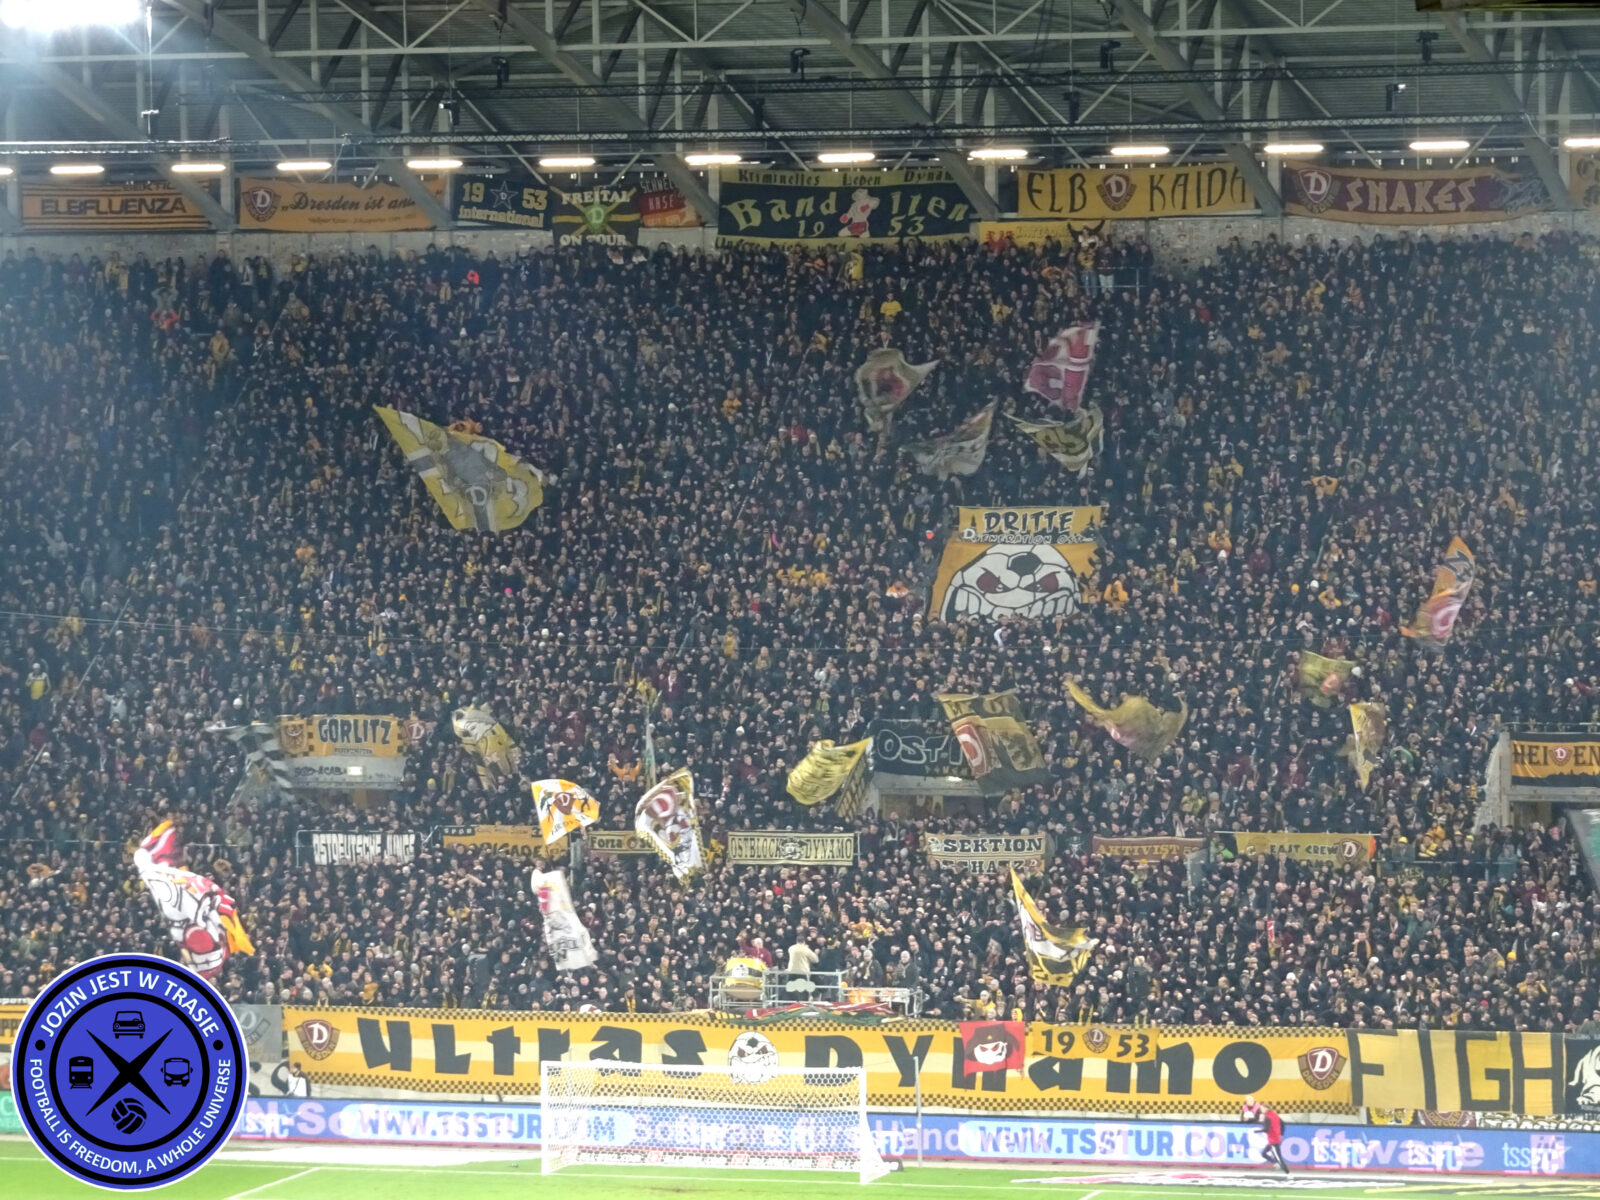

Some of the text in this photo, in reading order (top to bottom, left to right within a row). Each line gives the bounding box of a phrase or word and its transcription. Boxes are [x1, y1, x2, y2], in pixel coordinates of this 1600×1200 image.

[41, 197, 188, 216] ELBFLUENZA
[462, 182, 485, 203] 19
[522, 188, 548, 210] 53
[1346, 177, 1476, 213] SNAKES
[983, 510, 1075, 533] DRITTE
[730, 837, 853, 859] OSTBLOCK DYNAMO
[943, 837, 1043, 853] SEKTION
[1041, 1030, 1075, 1054] 19
[1117, 1033, 1150, 1058] 53
